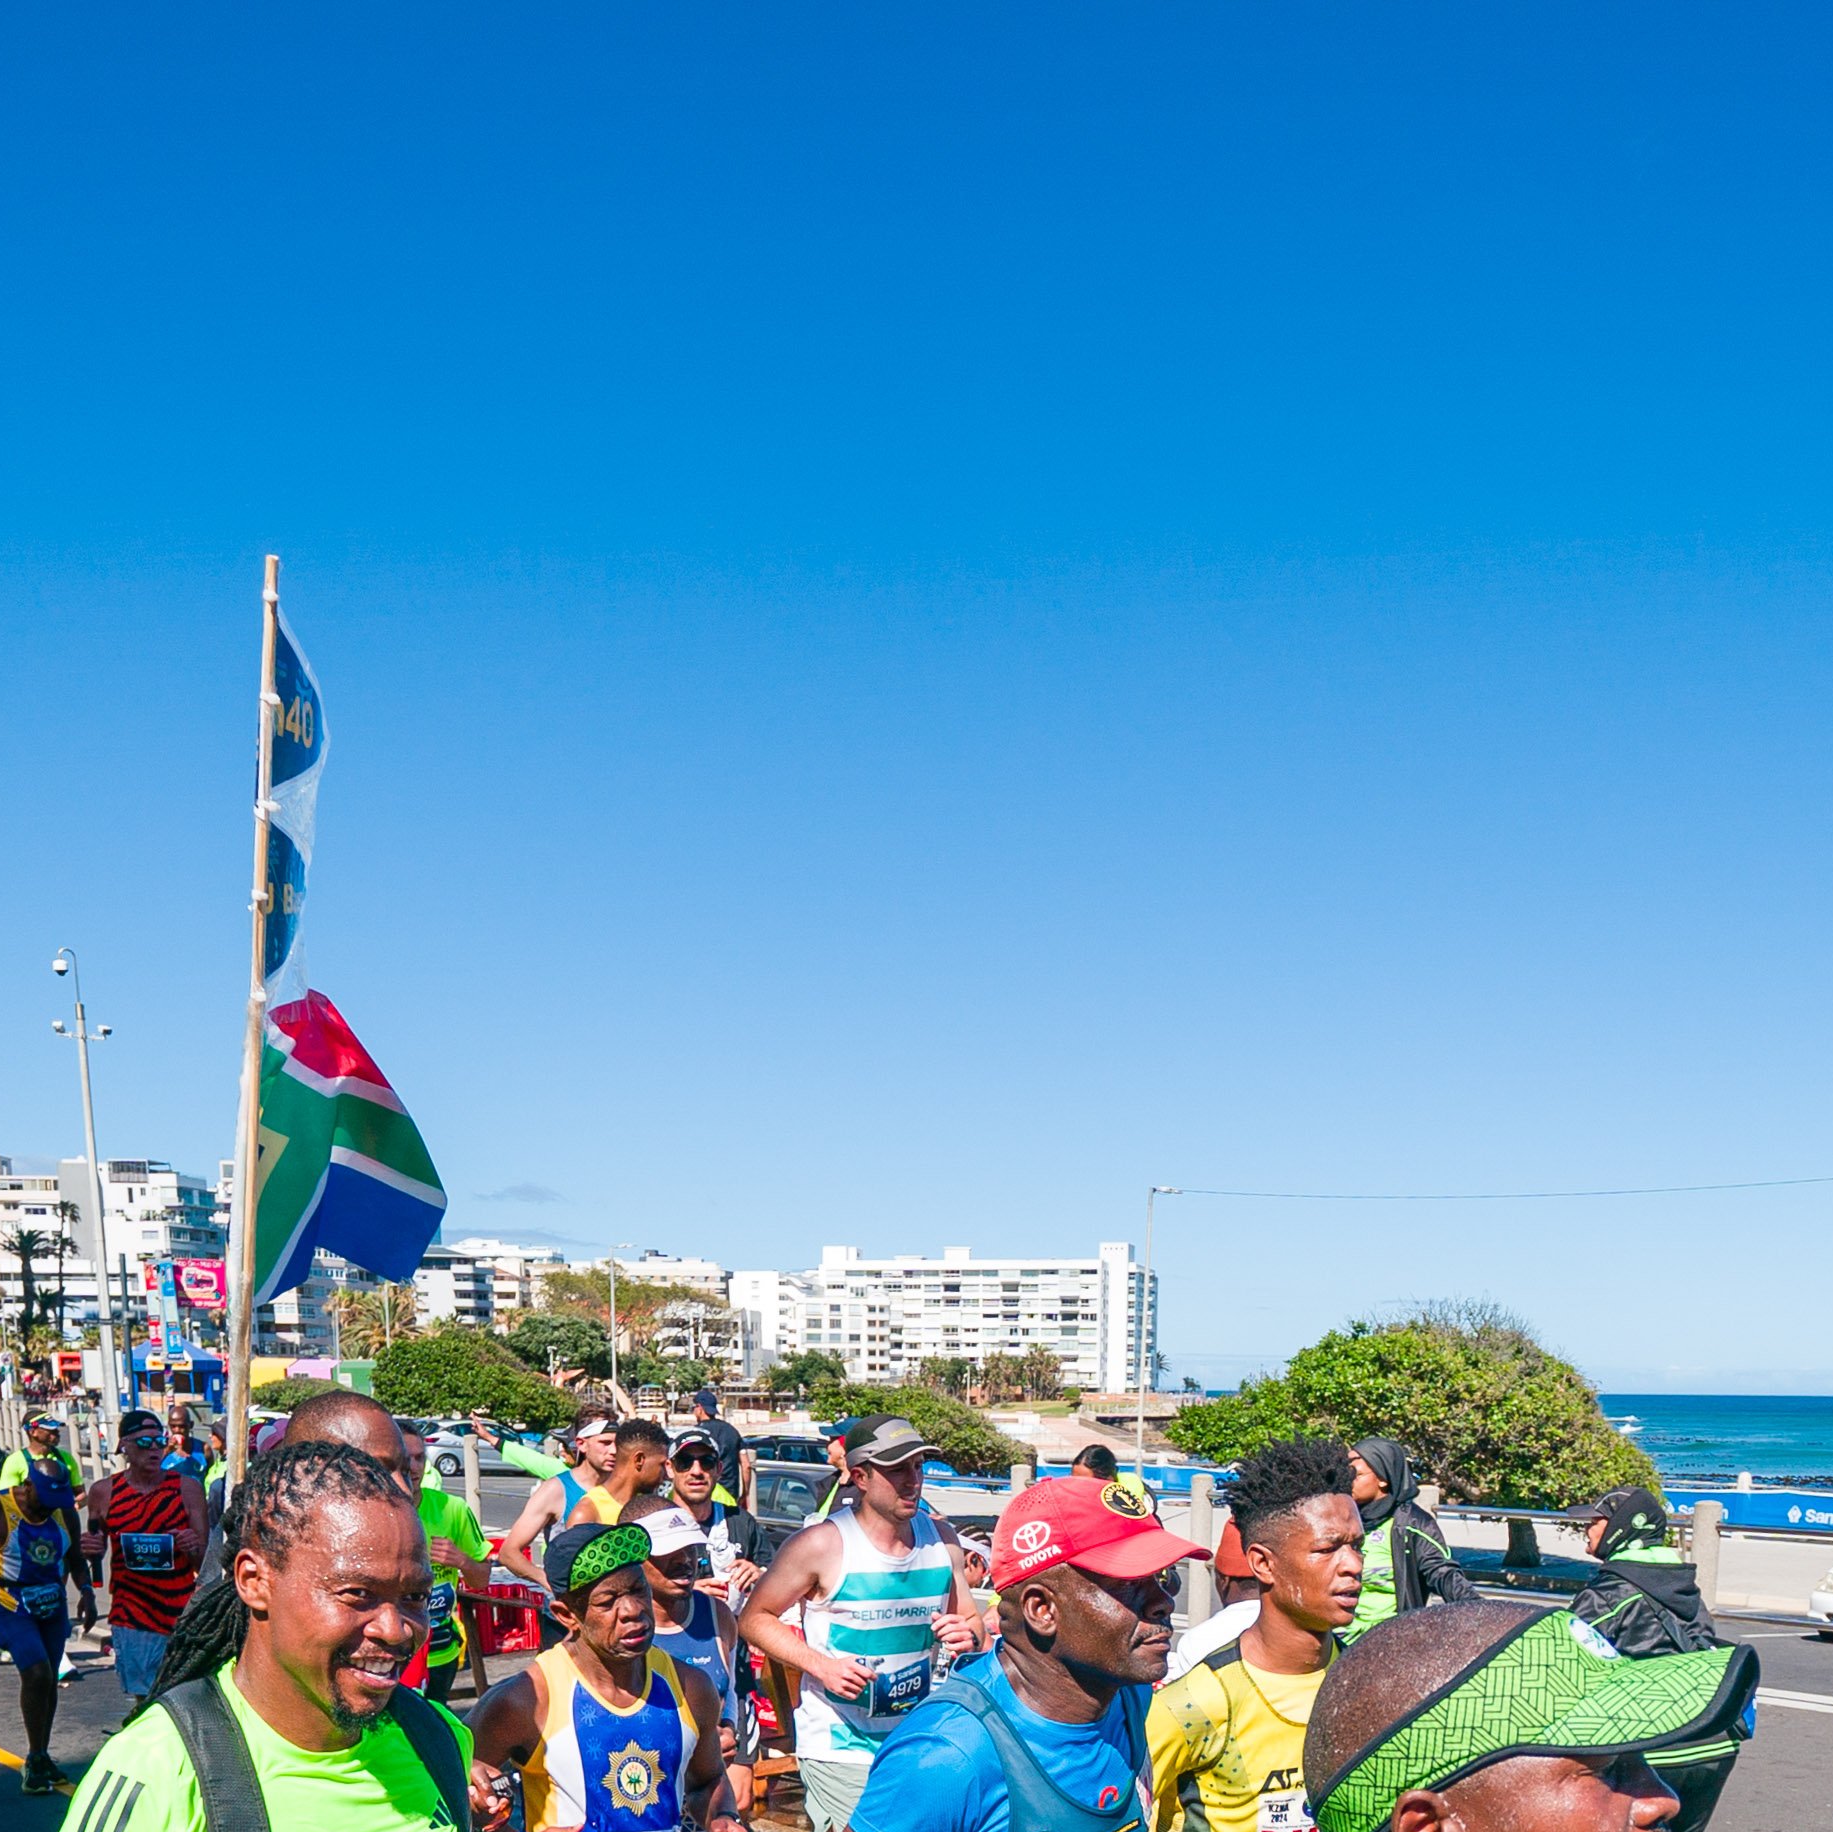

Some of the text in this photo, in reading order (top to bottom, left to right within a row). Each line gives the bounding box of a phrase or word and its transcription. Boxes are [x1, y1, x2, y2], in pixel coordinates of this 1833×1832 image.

[1018, 1544, 1062, 1571] TOYOTA
[852, 1608, 893, 1621] CELTIC
[888, 1675, 922, 1698] 4979
